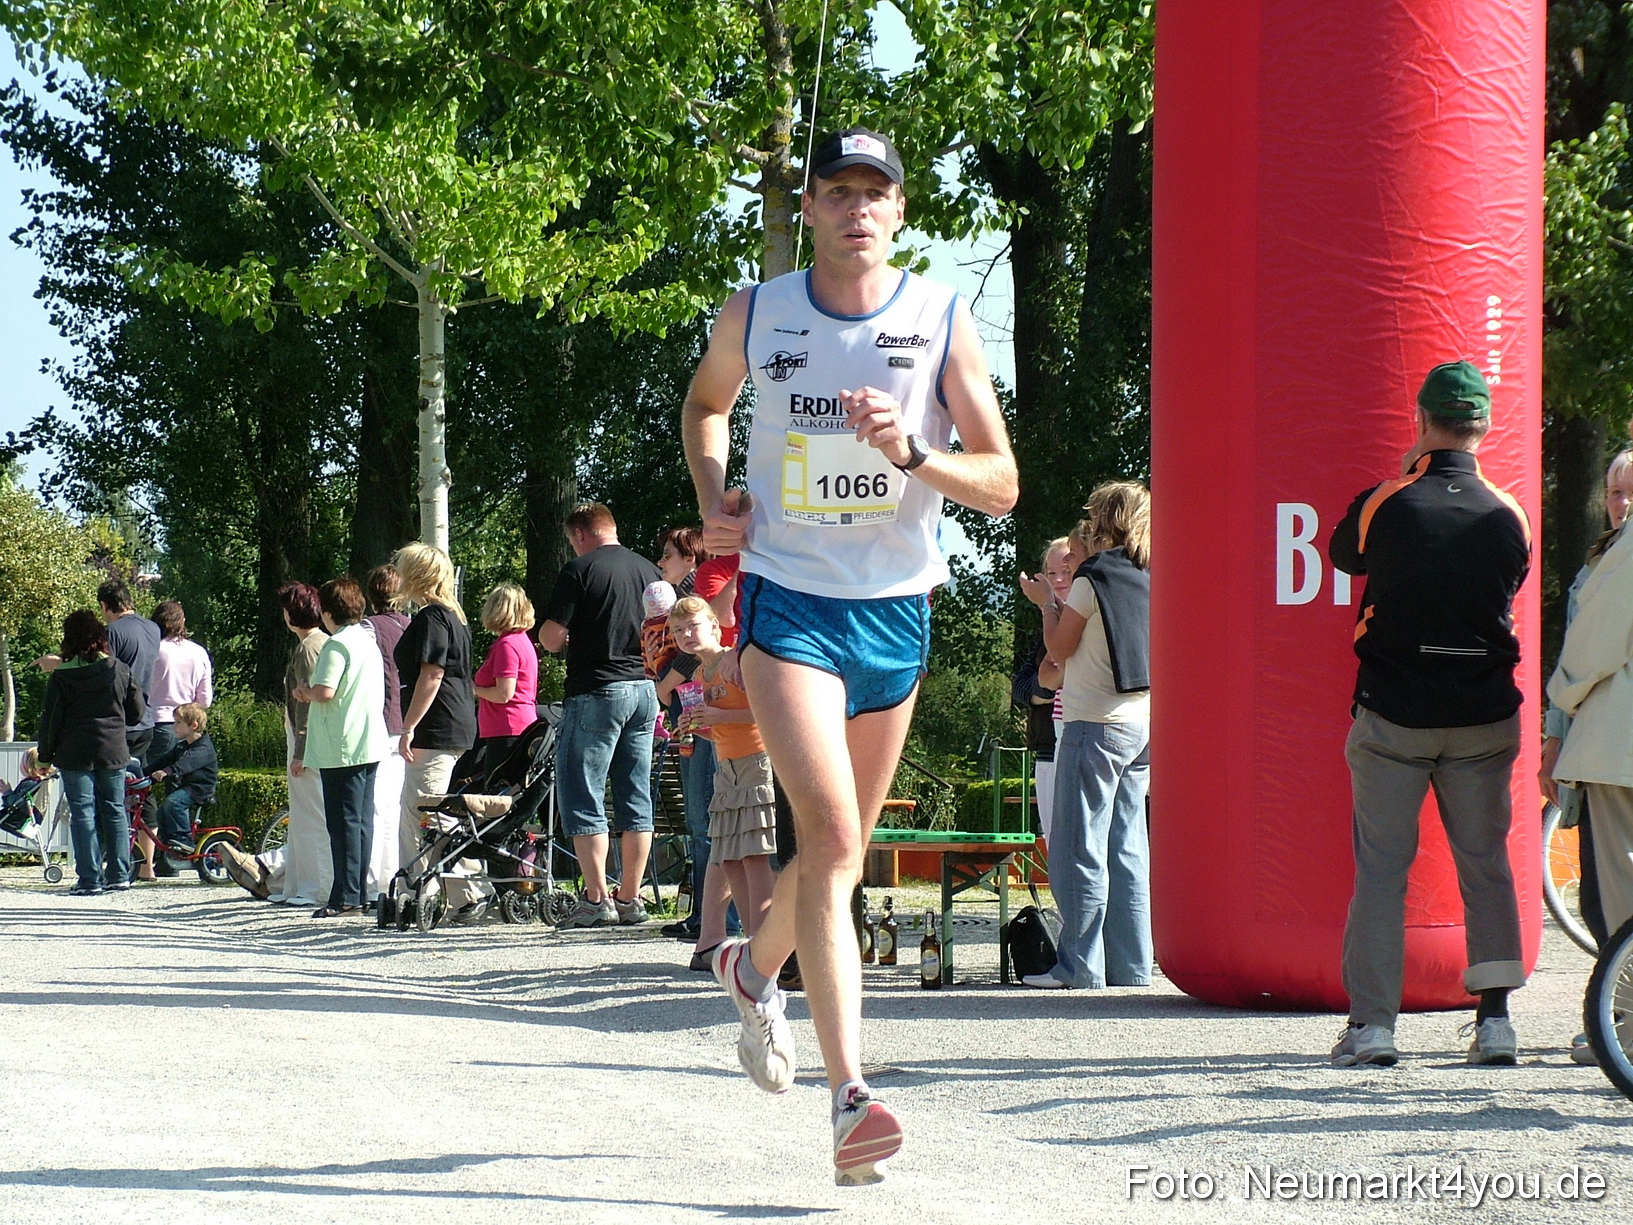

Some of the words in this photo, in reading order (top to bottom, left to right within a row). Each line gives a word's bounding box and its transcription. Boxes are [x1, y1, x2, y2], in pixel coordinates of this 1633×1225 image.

[1486, 295, 1502, 341] 1929
[875, 332, 931, 347] PowerBar
[816, 472, 889, 500] 1066
